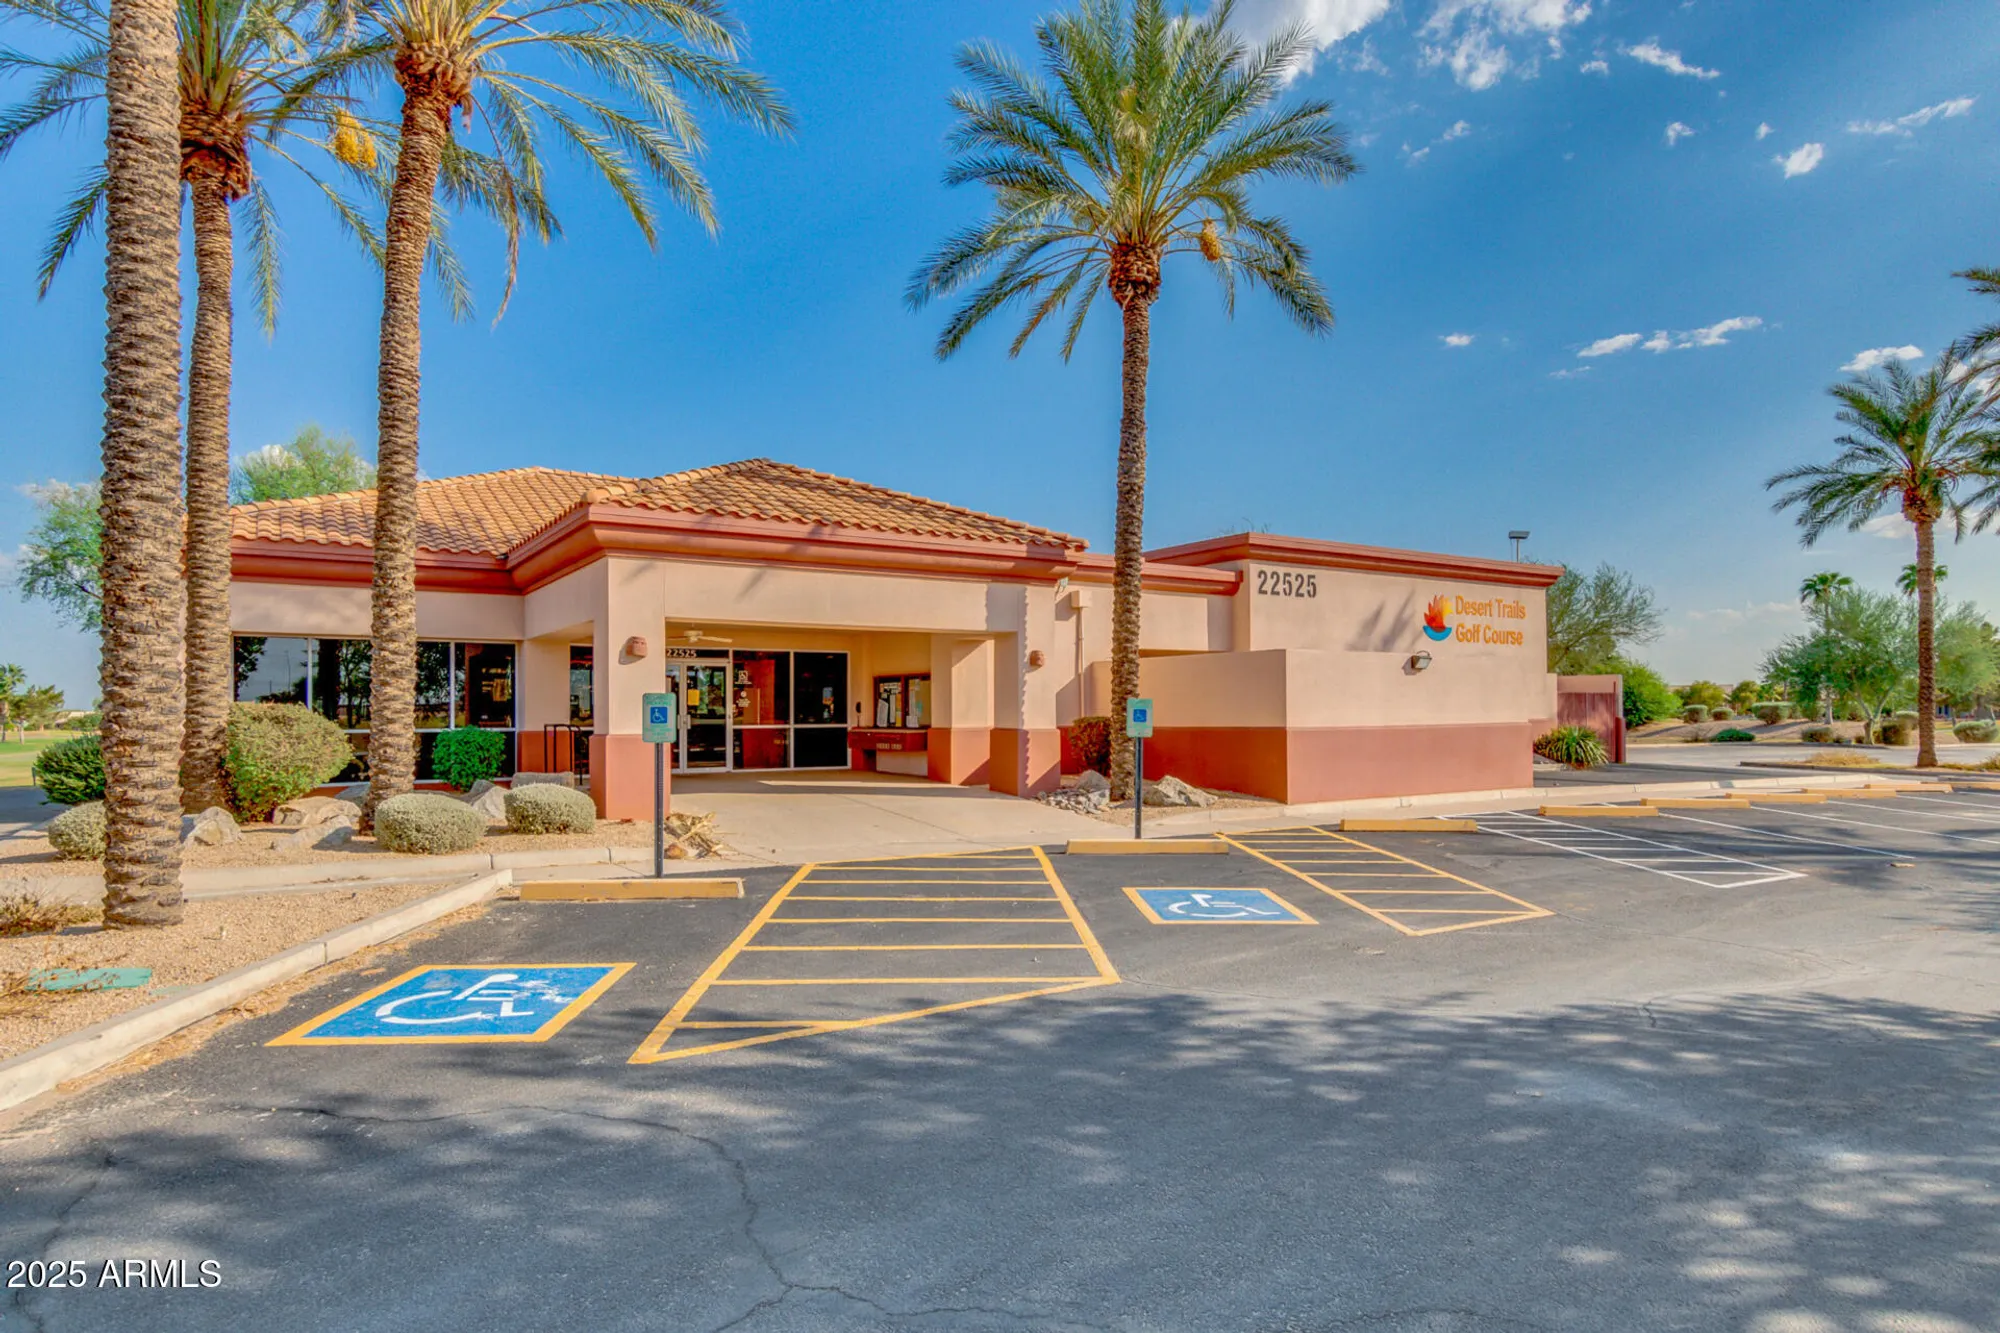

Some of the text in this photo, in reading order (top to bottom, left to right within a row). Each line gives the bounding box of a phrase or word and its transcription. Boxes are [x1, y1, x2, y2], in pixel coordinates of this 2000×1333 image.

[1257, 569, 1317, 598] 22525
[1455, 595, 1526, 619] Desert Trails
[1455, 622, 1524, 646] Golf Course
[666, 648, 697, 659] 22525
